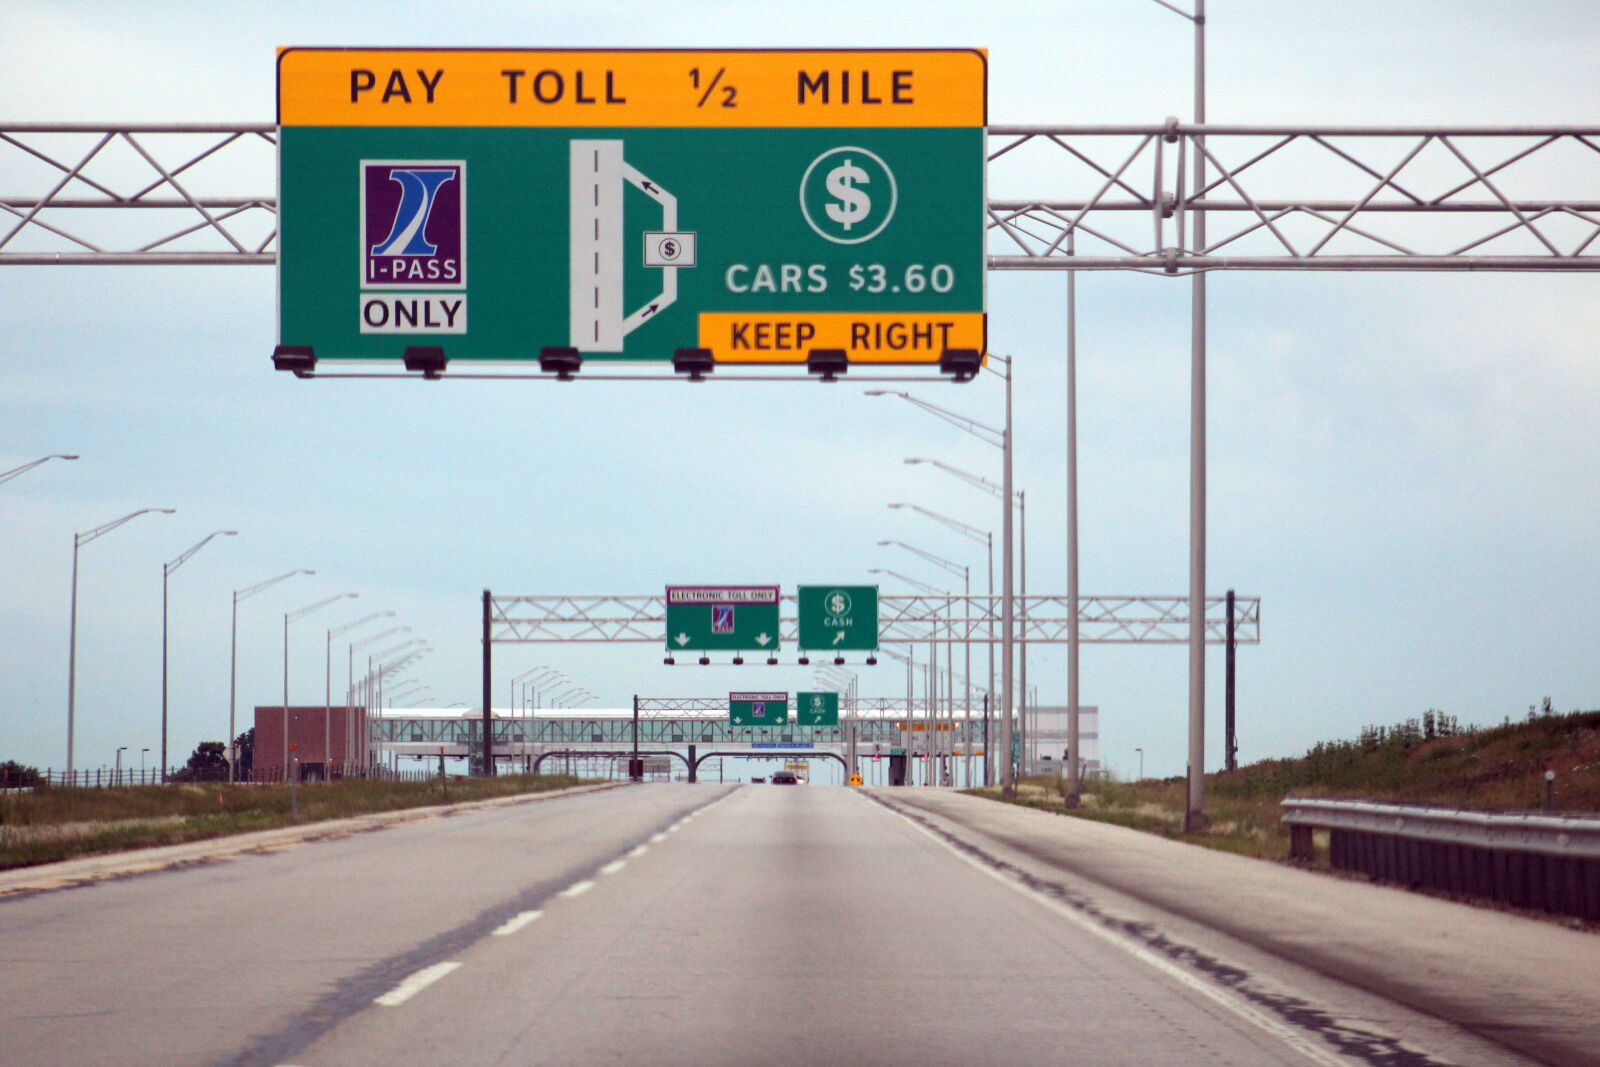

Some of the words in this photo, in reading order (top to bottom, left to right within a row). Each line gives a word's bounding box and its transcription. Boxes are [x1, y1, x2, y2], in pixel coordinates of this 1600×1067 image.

[350, 70, 444, 104] PAY
[501, 70, 627, 104] TOLL
[797, 70, 915, 104] MILE
[370, 259, 457, 280] I-PASS
[725, 264, 828, 293] CARS
[849, 264, 955, 293] $3.60
[363, 300, 462, 328] ONLY
[732, 323, 816, 351] KEEP
[851, 323, 955, 351] RIGHT
[671, 590, 724, 600] ELECTRONIC
[728, 590, 745, 600] TOLL
[751, 590, 773, 600] ONLY
[824, 618, 853, 627] CASH
